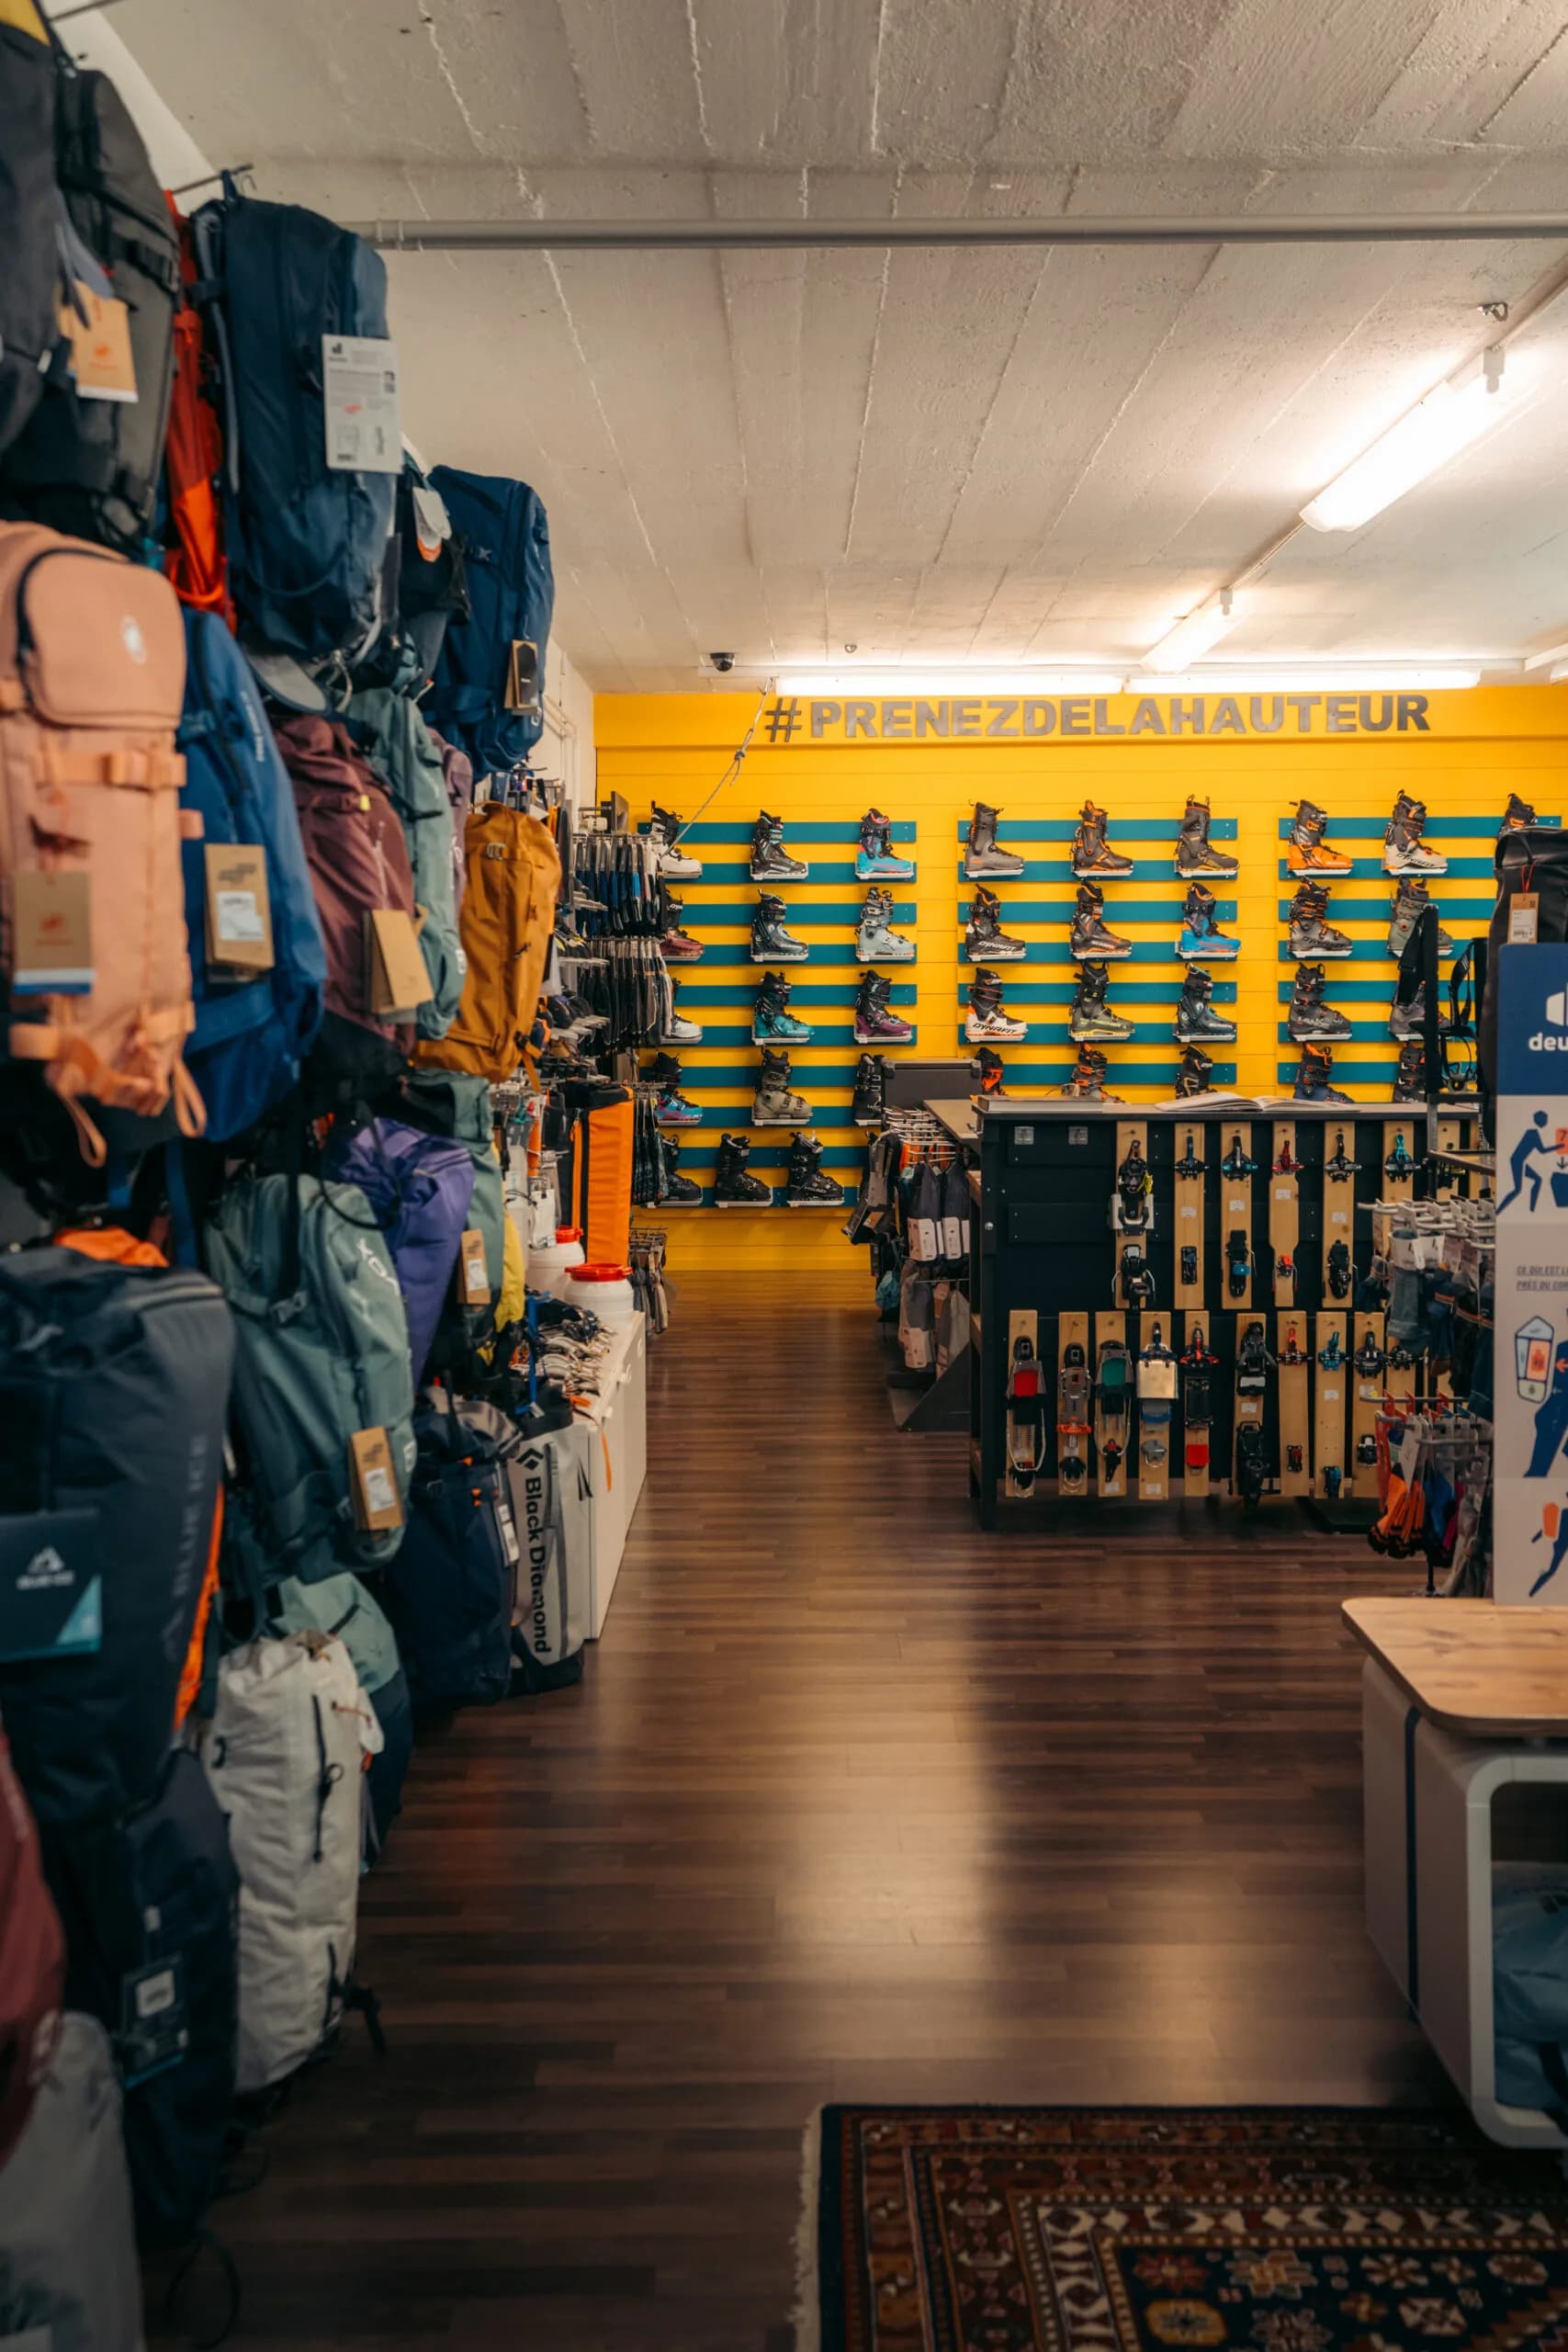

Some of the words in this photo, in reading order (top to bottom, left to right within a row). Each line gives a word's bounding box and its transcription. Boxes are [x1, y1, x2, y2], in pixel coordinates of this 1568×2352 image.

[764, 694, 1430, 742] #PRENEZDELAHAUTEUR
[977, 940, 1017, 951] DYNAFIT
[973, 1023, 1017, 1034] DYNAFIT
[525, 1476, 544, 1544] Black
[529, 1545, 551, 1654] Diamond
